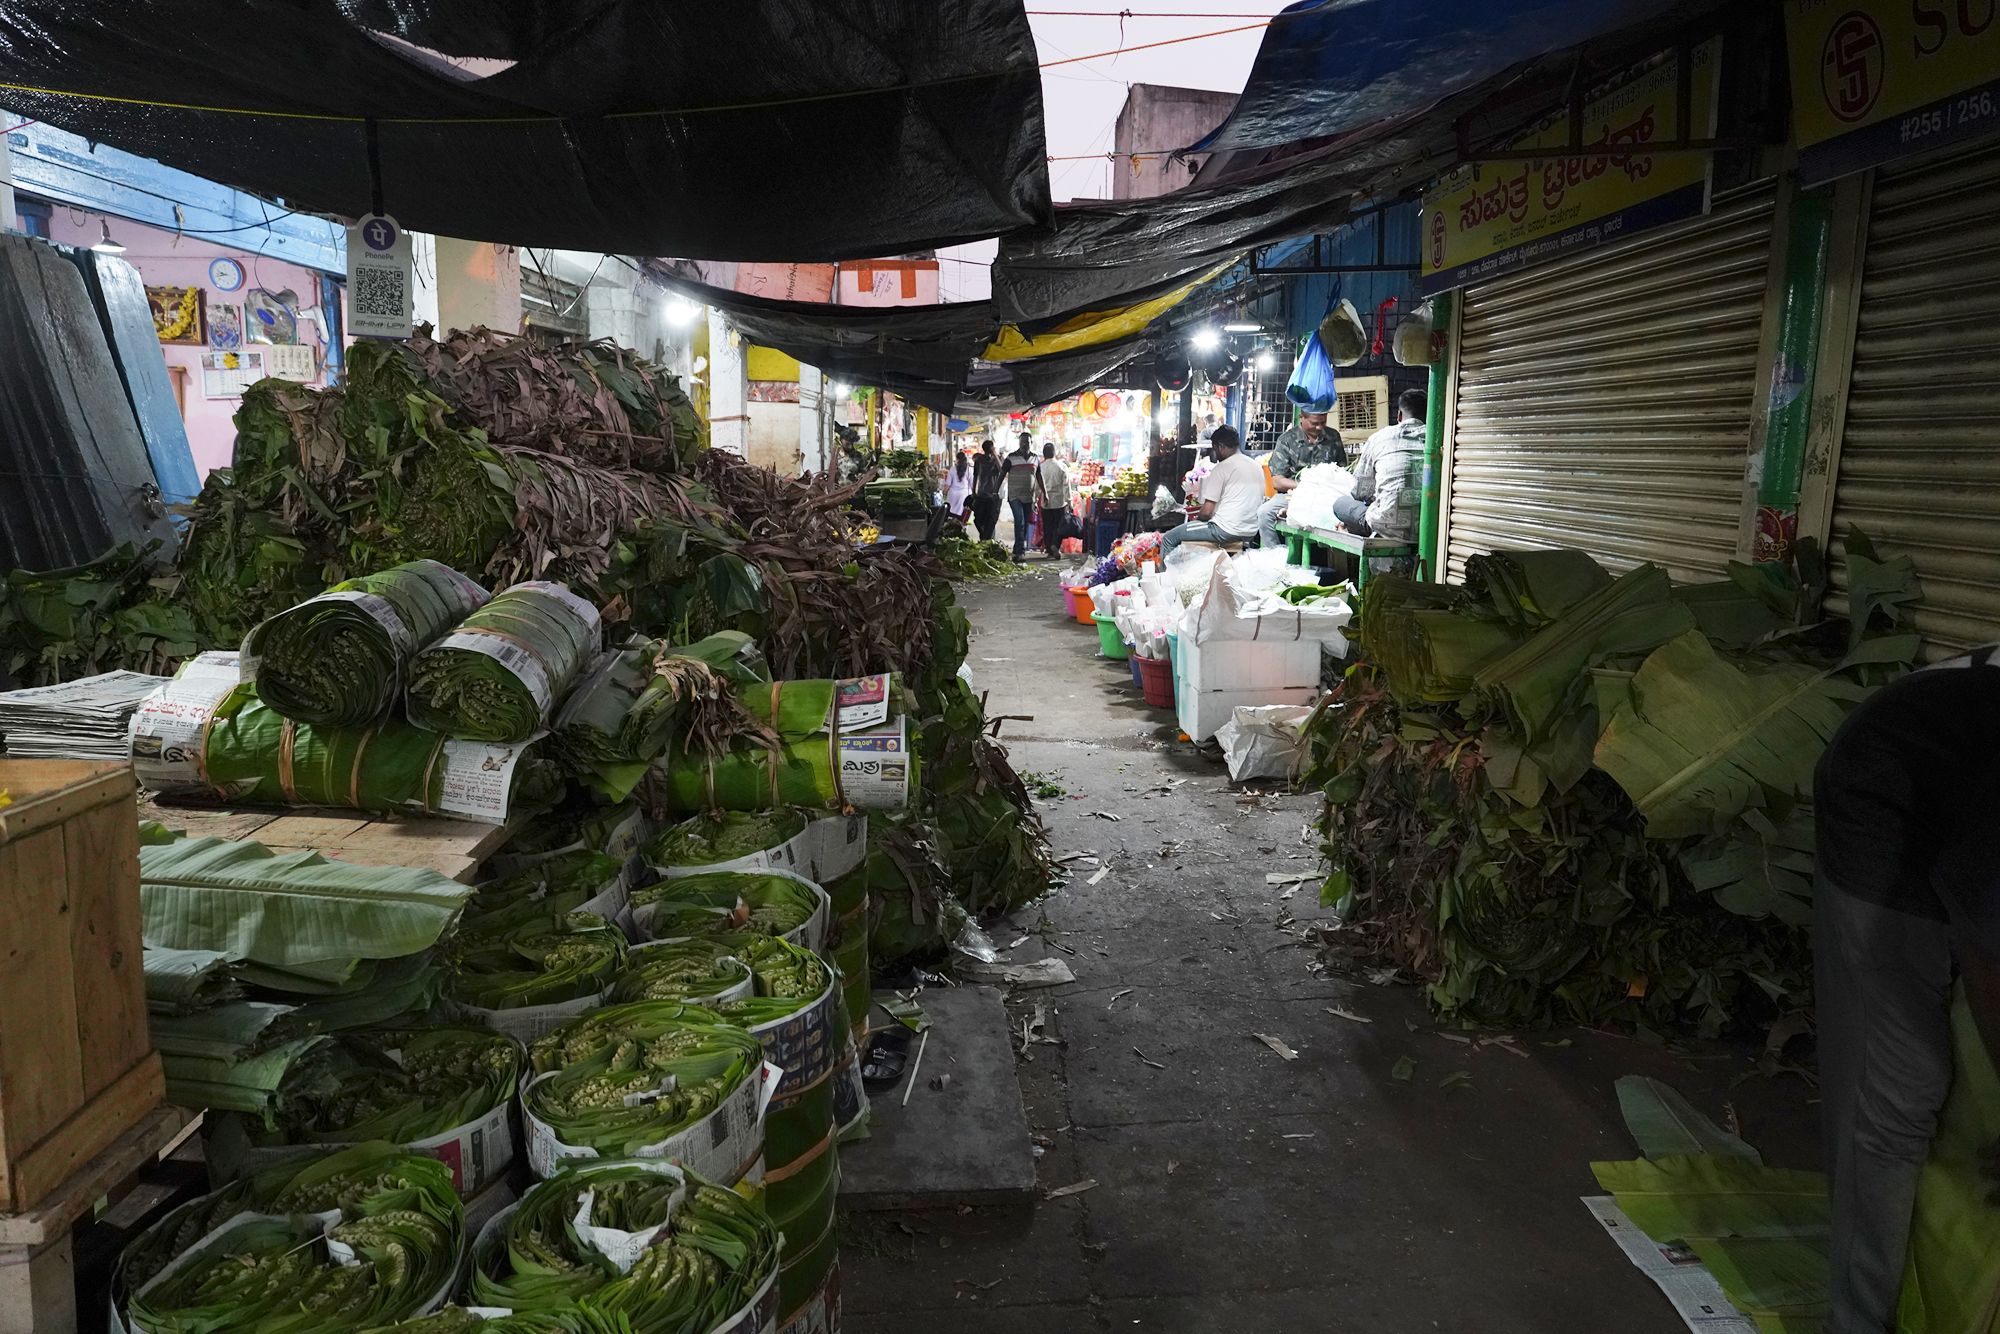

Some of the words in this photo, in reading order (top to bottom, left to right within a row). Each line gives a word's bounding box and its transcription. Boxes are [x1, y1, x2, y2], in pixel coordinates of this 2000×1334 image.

[1900, 111, 1943, 144] #255
[1957, 91, 1998, 125] 256,
[365, 251, 394, 261] PhonePe
[843, 759, 880, 775] ಮಿತ್ರ
